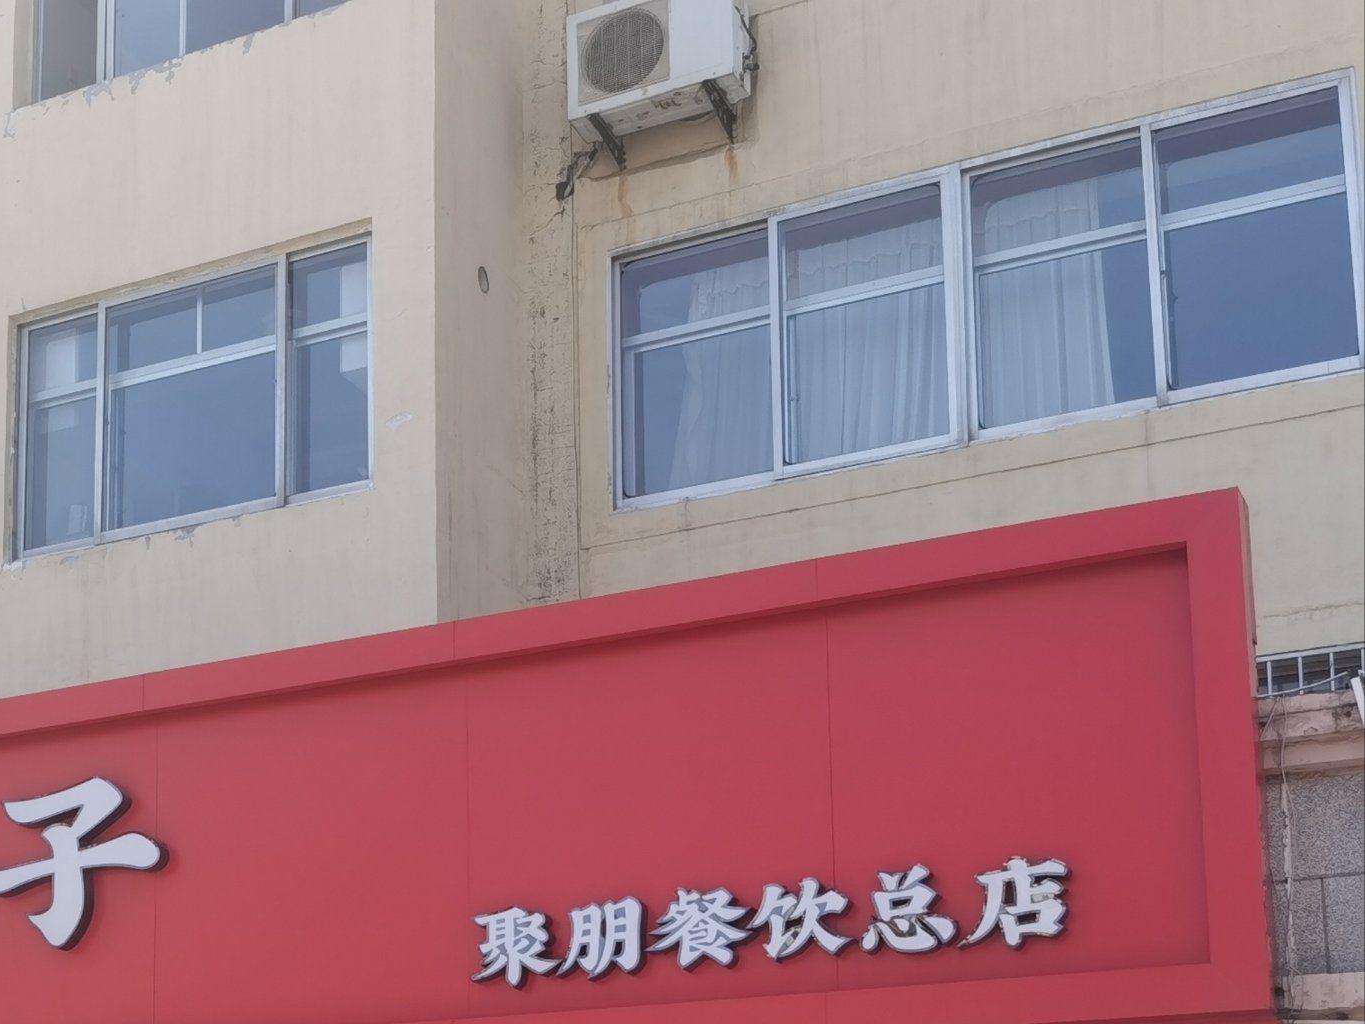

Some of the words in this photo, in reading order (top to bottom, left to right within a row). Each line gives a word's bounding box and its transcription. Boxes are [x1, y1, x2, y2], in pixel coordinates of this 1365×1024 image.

[471, 856, 1069, 987] 聚朋餐饮总店
